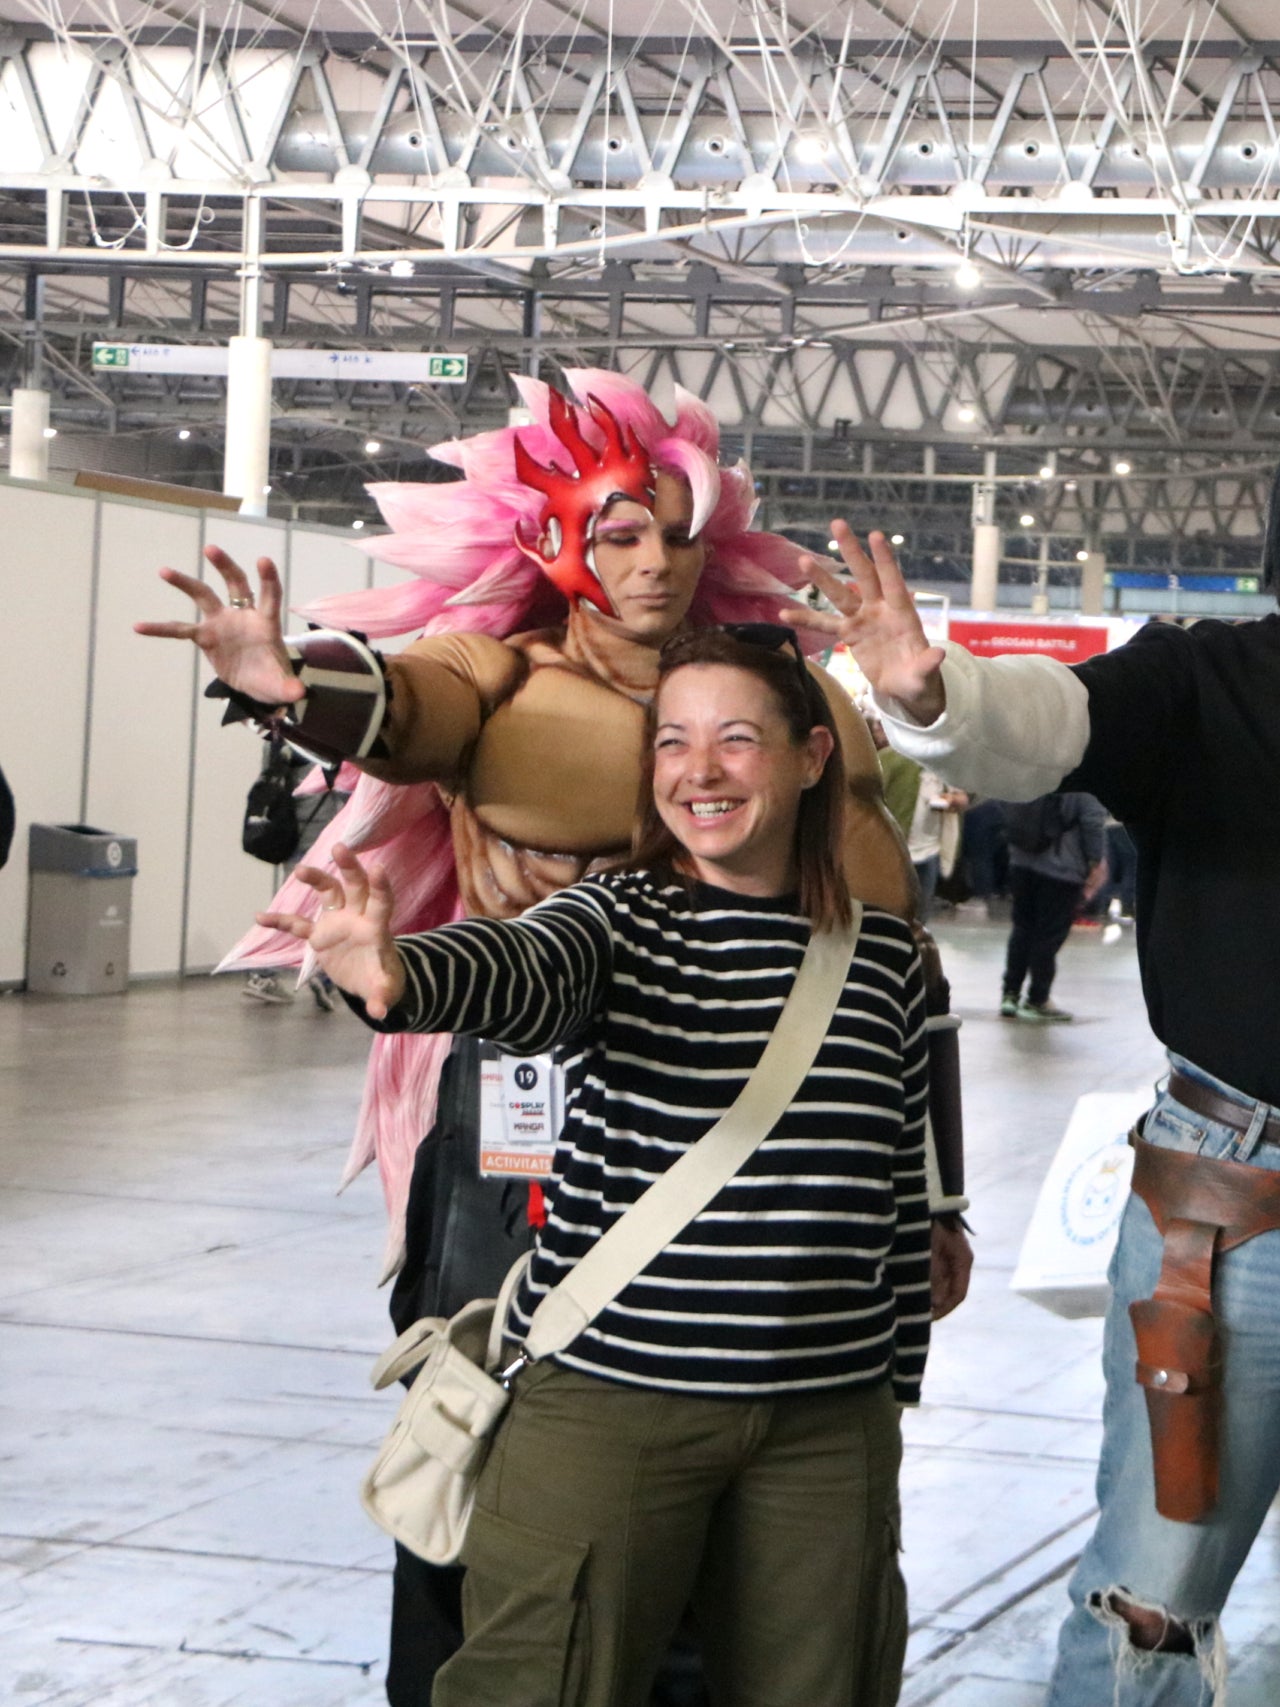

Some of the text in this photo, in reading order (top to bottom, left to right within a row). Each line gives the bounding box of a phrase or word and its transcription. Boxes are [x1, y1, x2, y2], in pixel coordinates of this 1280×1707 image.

[518, 1070, 534, 1085] 19
[513, 1122, 544, 1131] MANGA
[485, 1155, 551, 1171] ACTIVITATS
